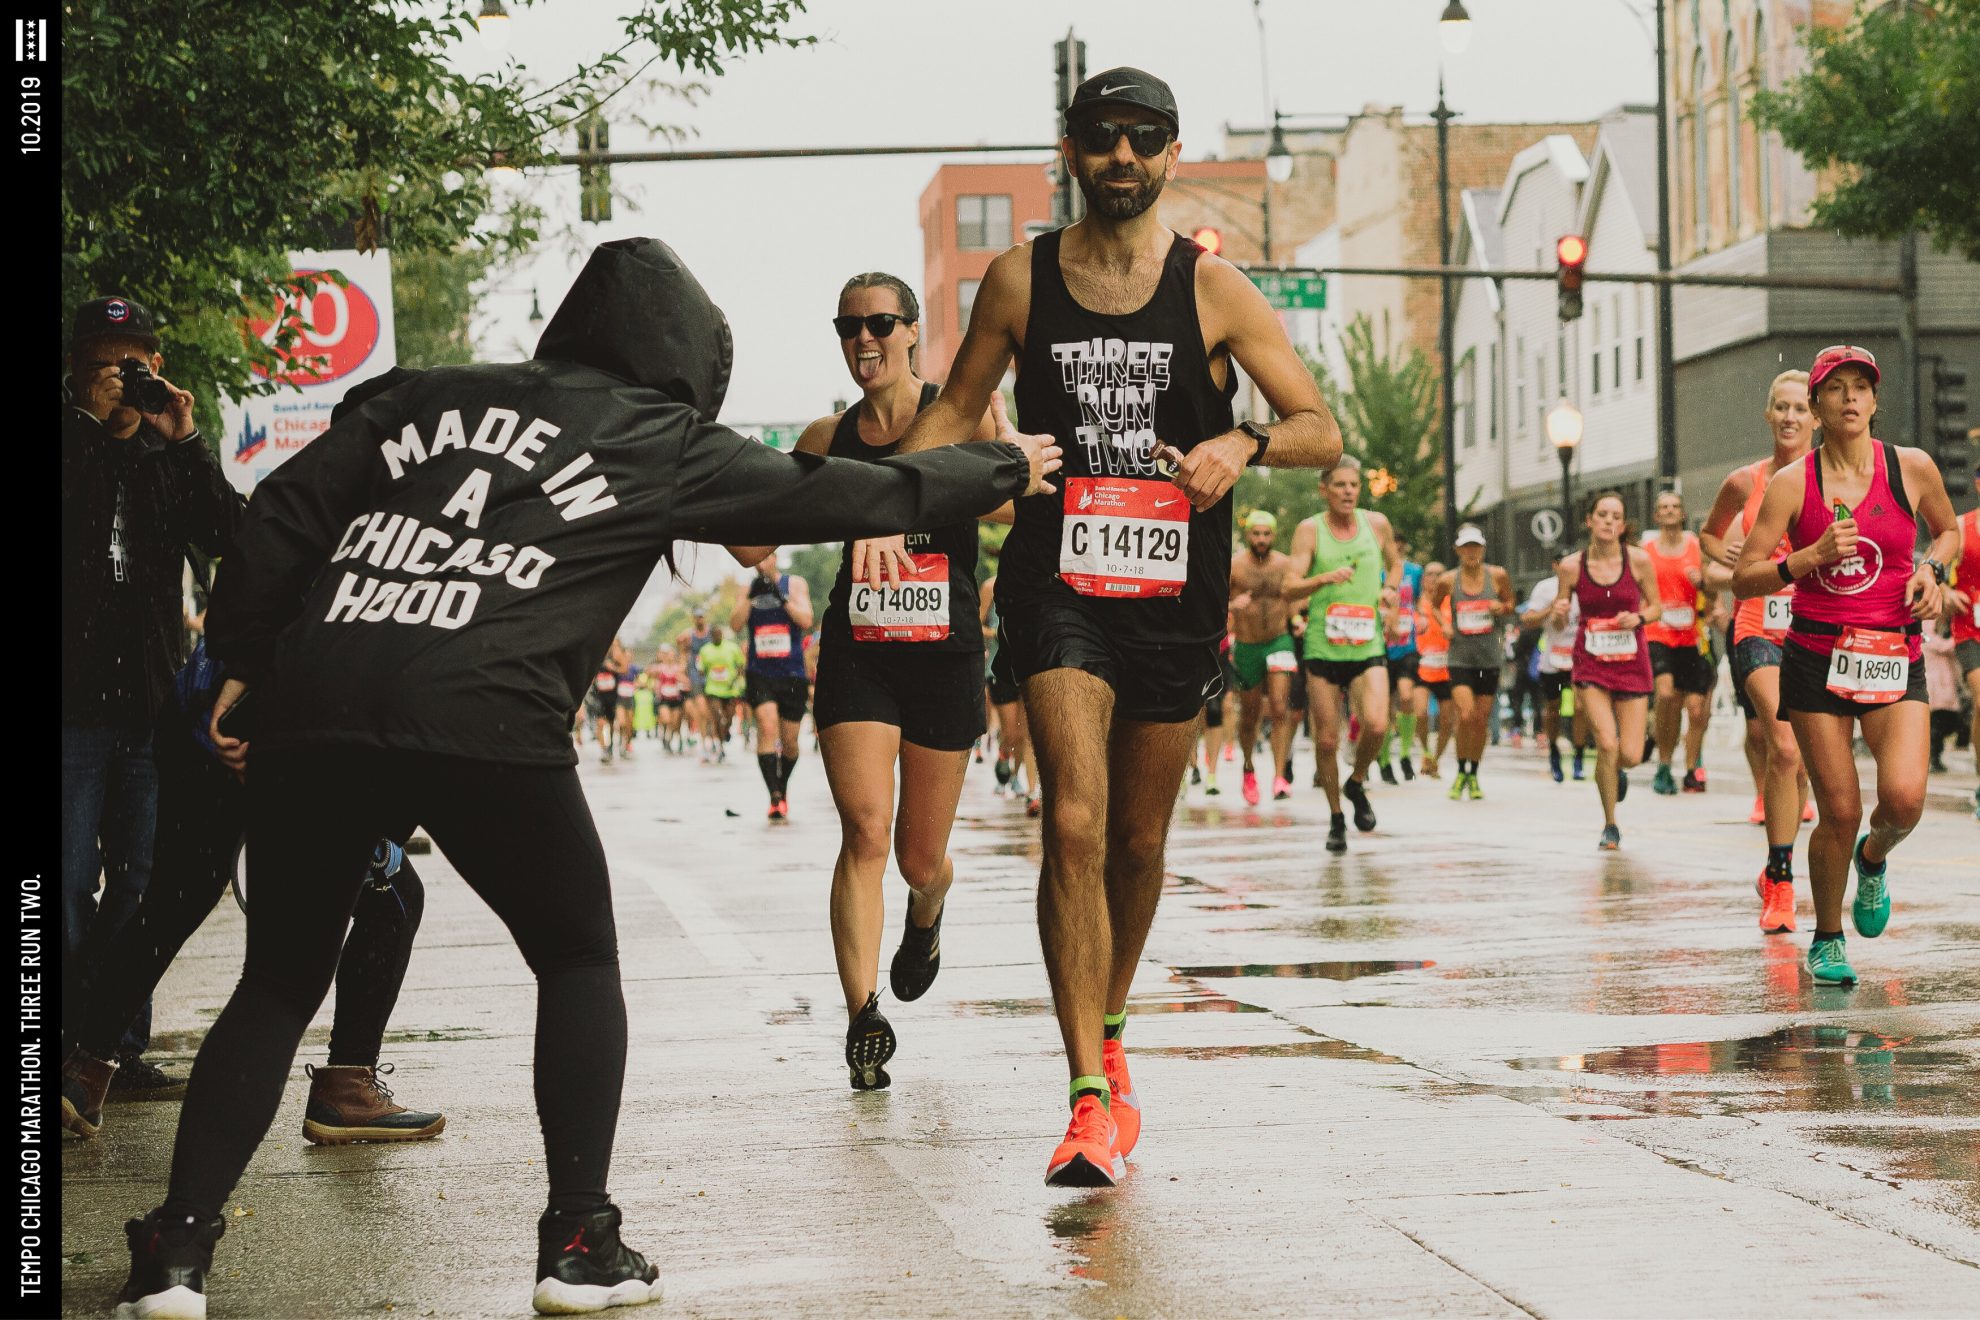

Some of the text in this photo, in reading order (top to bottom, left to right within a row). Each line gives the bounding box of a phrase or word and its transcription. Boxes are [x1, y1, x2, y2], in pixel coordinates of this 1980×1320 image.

[1051, 337, 1173, 393] THREE
[273, 418, 330, 433] Chicag
[1077, 383, 1156, 432] RUN
[380, 407, 618, 521] MADE IN
[1075, 426, 1156, 476] TWO
[441, 468, 492, 529] A
[1094, 492, 1120, 501] Chicago
[1094, 499, 1126, 507] Marathon
[331, 512, 556, 589] CHICAGO
[907, 533, 931, 545] CITY
[1072, 522, 1181, 562] C 14129
[324, 571, 481, 630] HOOD
[856, 586, 942, 612] C 14089
[1769, 600, 1777, 618] C
[1836, 654, 1902, 681] D 18590
